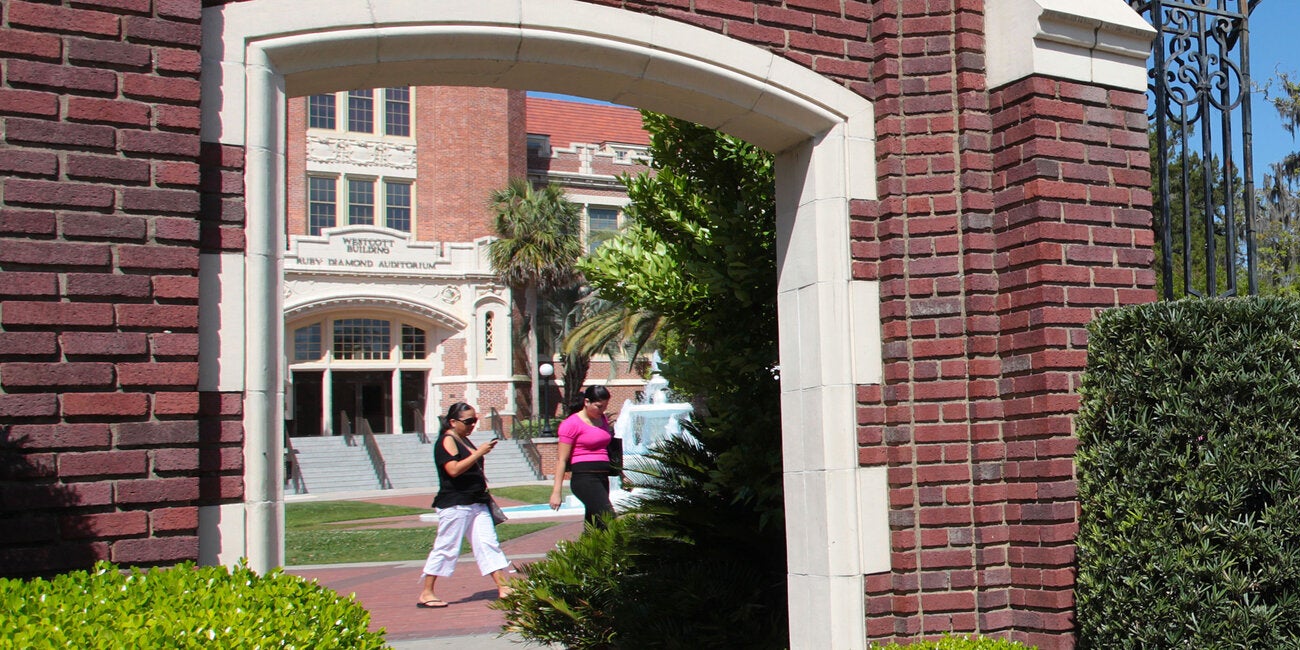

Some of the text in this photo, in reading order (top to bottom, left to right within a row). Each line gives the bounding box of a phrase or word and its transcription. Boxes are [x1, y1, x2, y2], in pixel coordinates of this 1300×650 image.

[342, 237, 395, 248] WESTCOTT
[347, 245, 390, 254] BUILDING
[296, 257, 436, 270] RUBY DIAMOND AUDITORIUM
